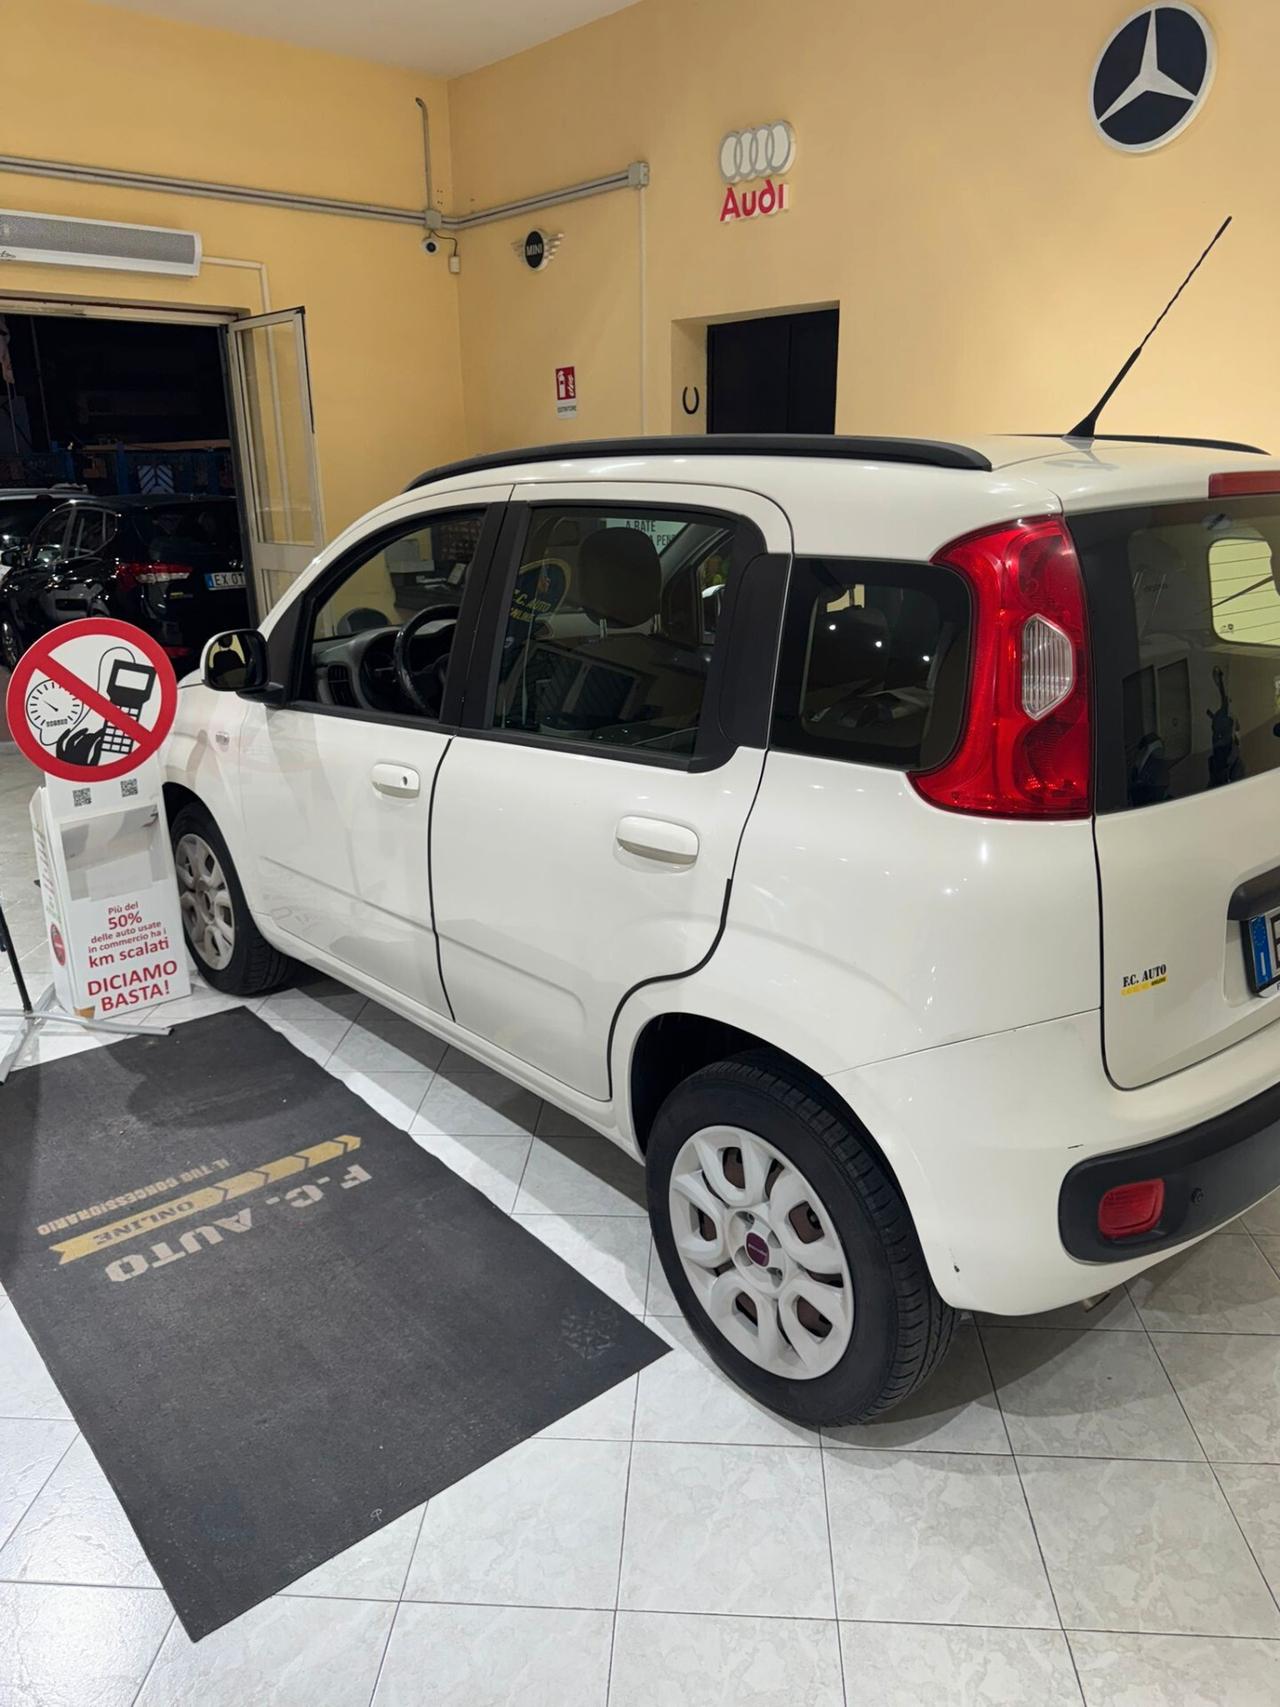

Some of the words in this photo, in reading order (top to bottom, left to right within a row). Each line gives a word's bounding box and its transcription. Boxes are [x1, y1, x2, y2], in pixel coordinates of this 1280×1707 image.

[720, 178, 785, 222] Audi
[526, 243, 543, 256] MINI
[214, 574, 228, 586] EX
[108, 905, 123, 915] Più
[125, 901, 139, 911] del
[108, 911, 142, 930] 50%
[88, 945, 98, 953] in
[99, 932, 149, 951] commercio
[150, 927, 162, 938] ha
[91, 932, 113, 944] delle
[115, 927, 136, 938] auto
[138, 920, 161, 933] usate
[89, 953, 115, 968] km
[119, 936, 169, 961] scalati
[88, 960, 177, 996] DICIAMO
[1142, 963, 1167, 982] AUTO
[101, 980, 170, 1012] BASTA!
[180, 1165, 213, 1184] TUO
[36, 1176, 180, 1236] CONCESSIONARIO
[93, 1200, 194, 1245] ONLINE
[105, 1208, 252, 1282] AUTO
